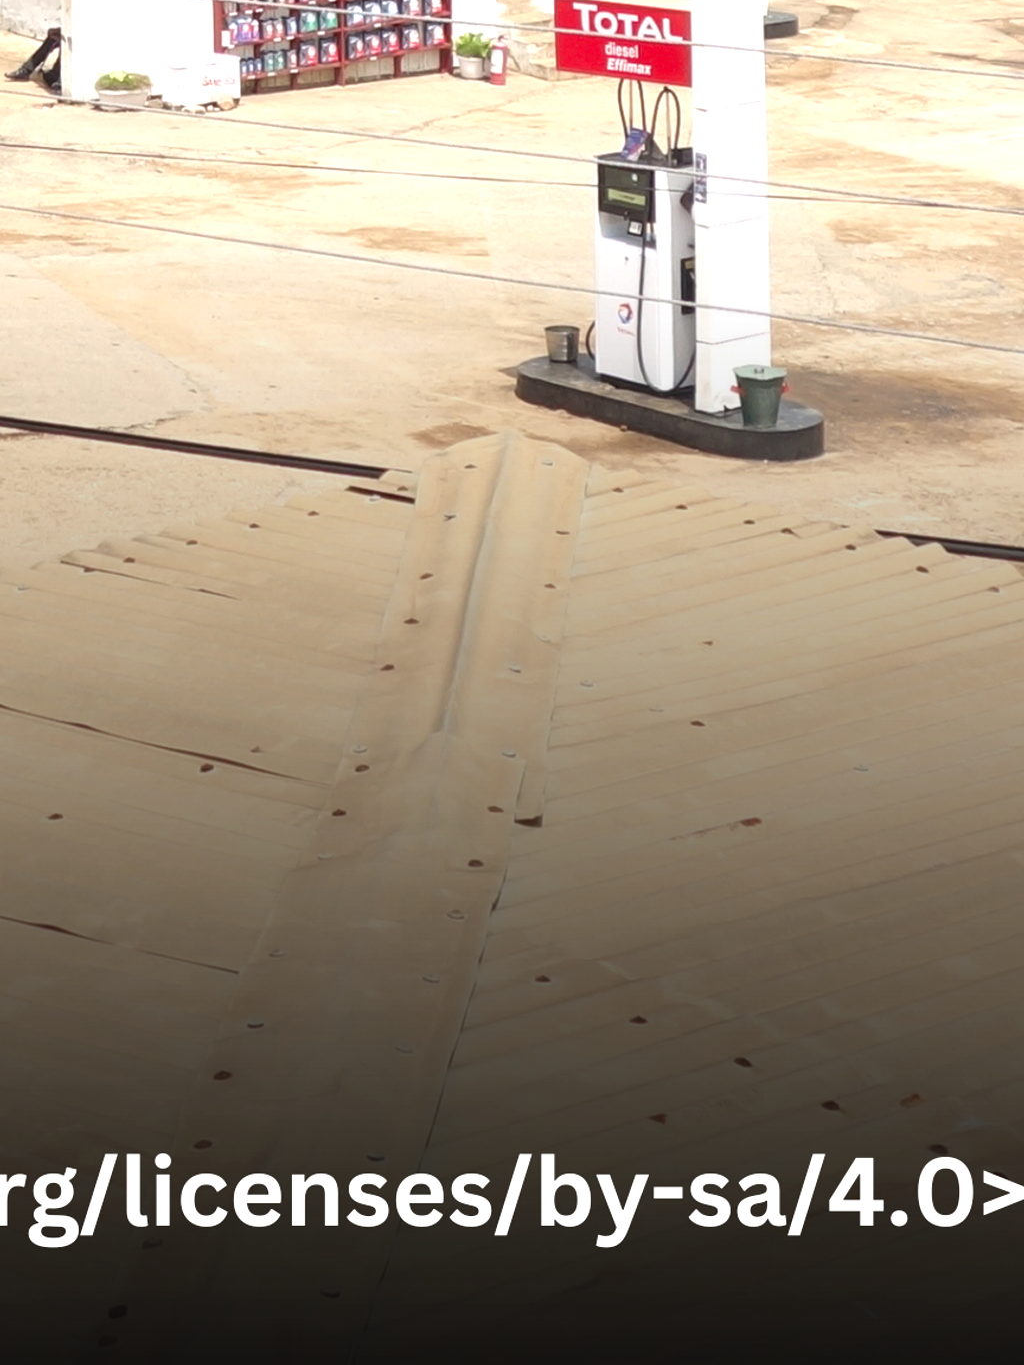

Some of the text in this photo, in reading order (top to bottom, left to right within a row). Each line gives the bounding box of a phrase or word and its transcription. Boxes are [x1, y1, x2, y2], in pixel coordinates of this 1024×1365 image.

[572, 2, 684, 42] TOTAL
[605, 42, 639, 59] diesel
[607, 57, 652, 76] Effimax
